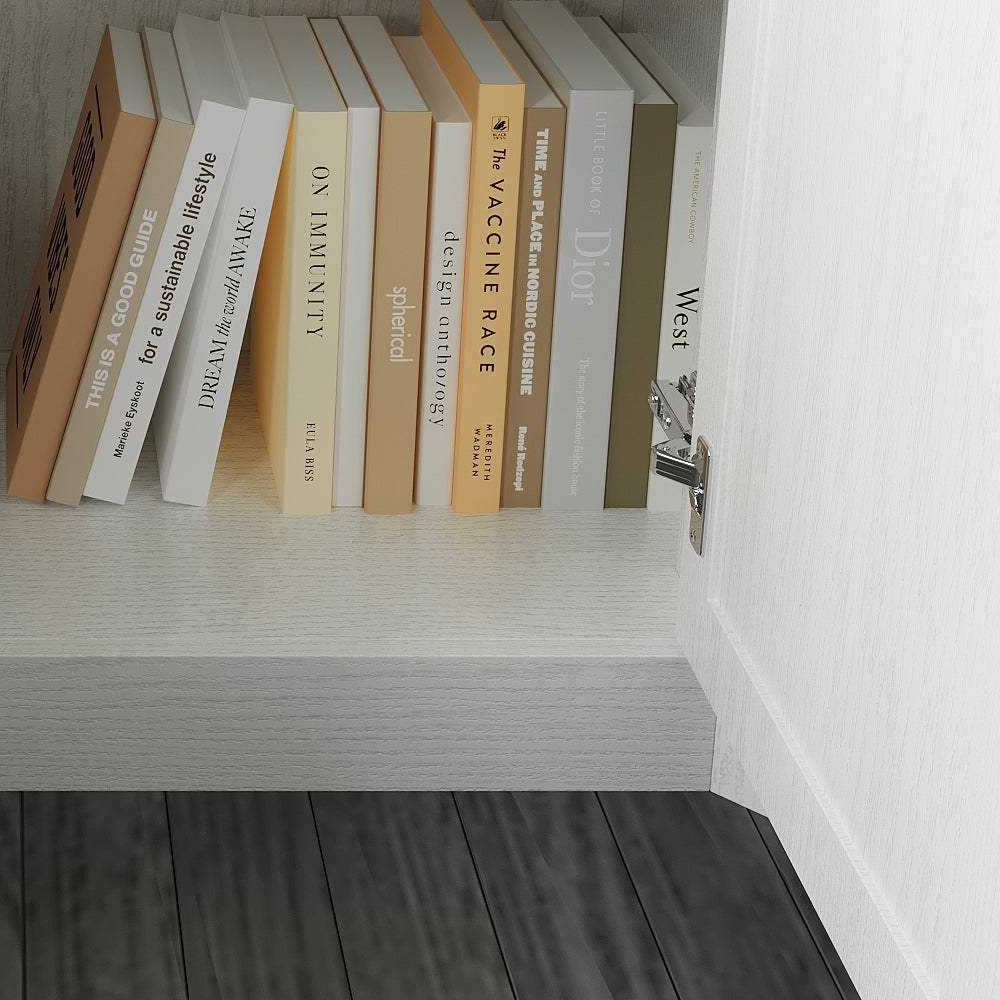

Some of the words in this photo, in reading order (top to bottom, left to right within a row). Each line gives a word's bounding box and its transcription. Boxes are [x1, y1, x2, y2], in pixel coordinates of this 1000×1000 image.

[534, 128, 549, 171] TIME
[593, 111, 607, 152] LITTLE
[492, 148, 507, 170] The
[590, 157, 604, 193] BOOK
[694, 151, 702, 166] THE
[182, 152, 217, 220] lifestyle
[311, 166, 330, 196] ON
[532, 173, 543, 198] AND
[690, 168, 700, 208] AMERICAN
[529, 200, 545, 252] PLACE
[589, 199, 601, 215] OF
[687, 209, 697, 244] COWBOY
[129, 208, 158, 268] GUIDE
[228, 206, 257, 277] AWAKE
[483, 178, 505, 293] VACCINE
[155, 224, 195, 322] sustainable
[306, 211, 328, 338] IMMUNITY
[436, 231, 460, 306] design
[527, 253, 538, 267] IN
[570, 228, 612, 306] Dior
[111, 271, 138, 327] GOOD
[223, 276, 241, 315] world
[523, 268, 540, 329] NORDIC
[106, 332, 121, 346] A
[150, 326, 163, 337] a
[215, 317, 232, 337] the
[386, 286, 416, 362] spherical
[671, 287, 700, 350] West
[98, 348, 115, 367] IS
[138, 340, 158, 365] for
[479, 309, 498, 373] RACE
[198, 339, 227, 409] DREAM
[520, 330, 537, 396] CUISINE
[578, 357, 590, 374] The
[85, 368, 109, 409] THIS
[113, 421, 132, 458] Marieke
[125, 381, 145, 419] Eyskoot
[305, 423, 316, 452] EULA
[517, 426, 528, 451] René
[304, 458, 315, 482] BISS
[472, 428, 481, 477] WADMAN
[483, 424, 493, 481] MEREDITH
